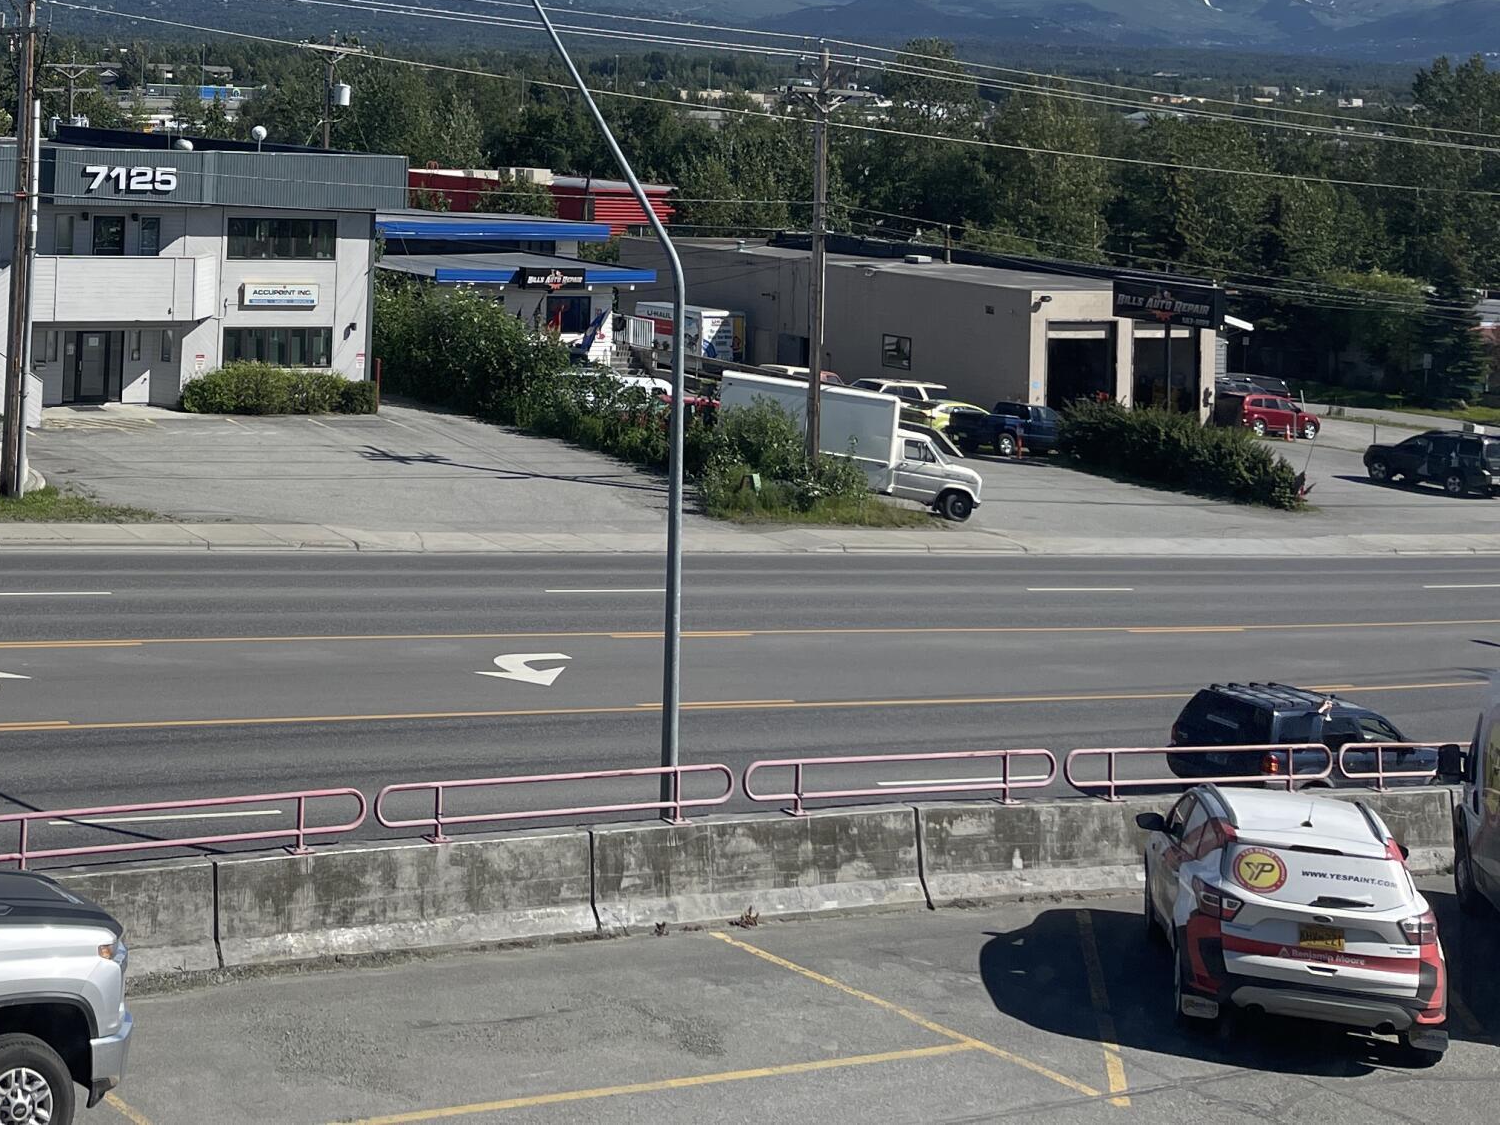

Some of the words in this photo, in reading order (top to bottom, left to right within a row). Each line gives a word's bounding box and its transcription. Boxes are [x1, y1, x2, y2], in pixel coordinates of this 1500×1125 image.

[85, 166, 177, 191] 7125
[646, 309, 671, 319] U-HAUL
[1145, 297, 1172, 310] AUTO
[1173, 301, 1210, 315] REPAIR
[1301, 870, 1398, 888] WWW.YESPAINT.COM
[1291, 949, 1334, 963] Benjamin
[1335, 955, 1366, 966] Moore
